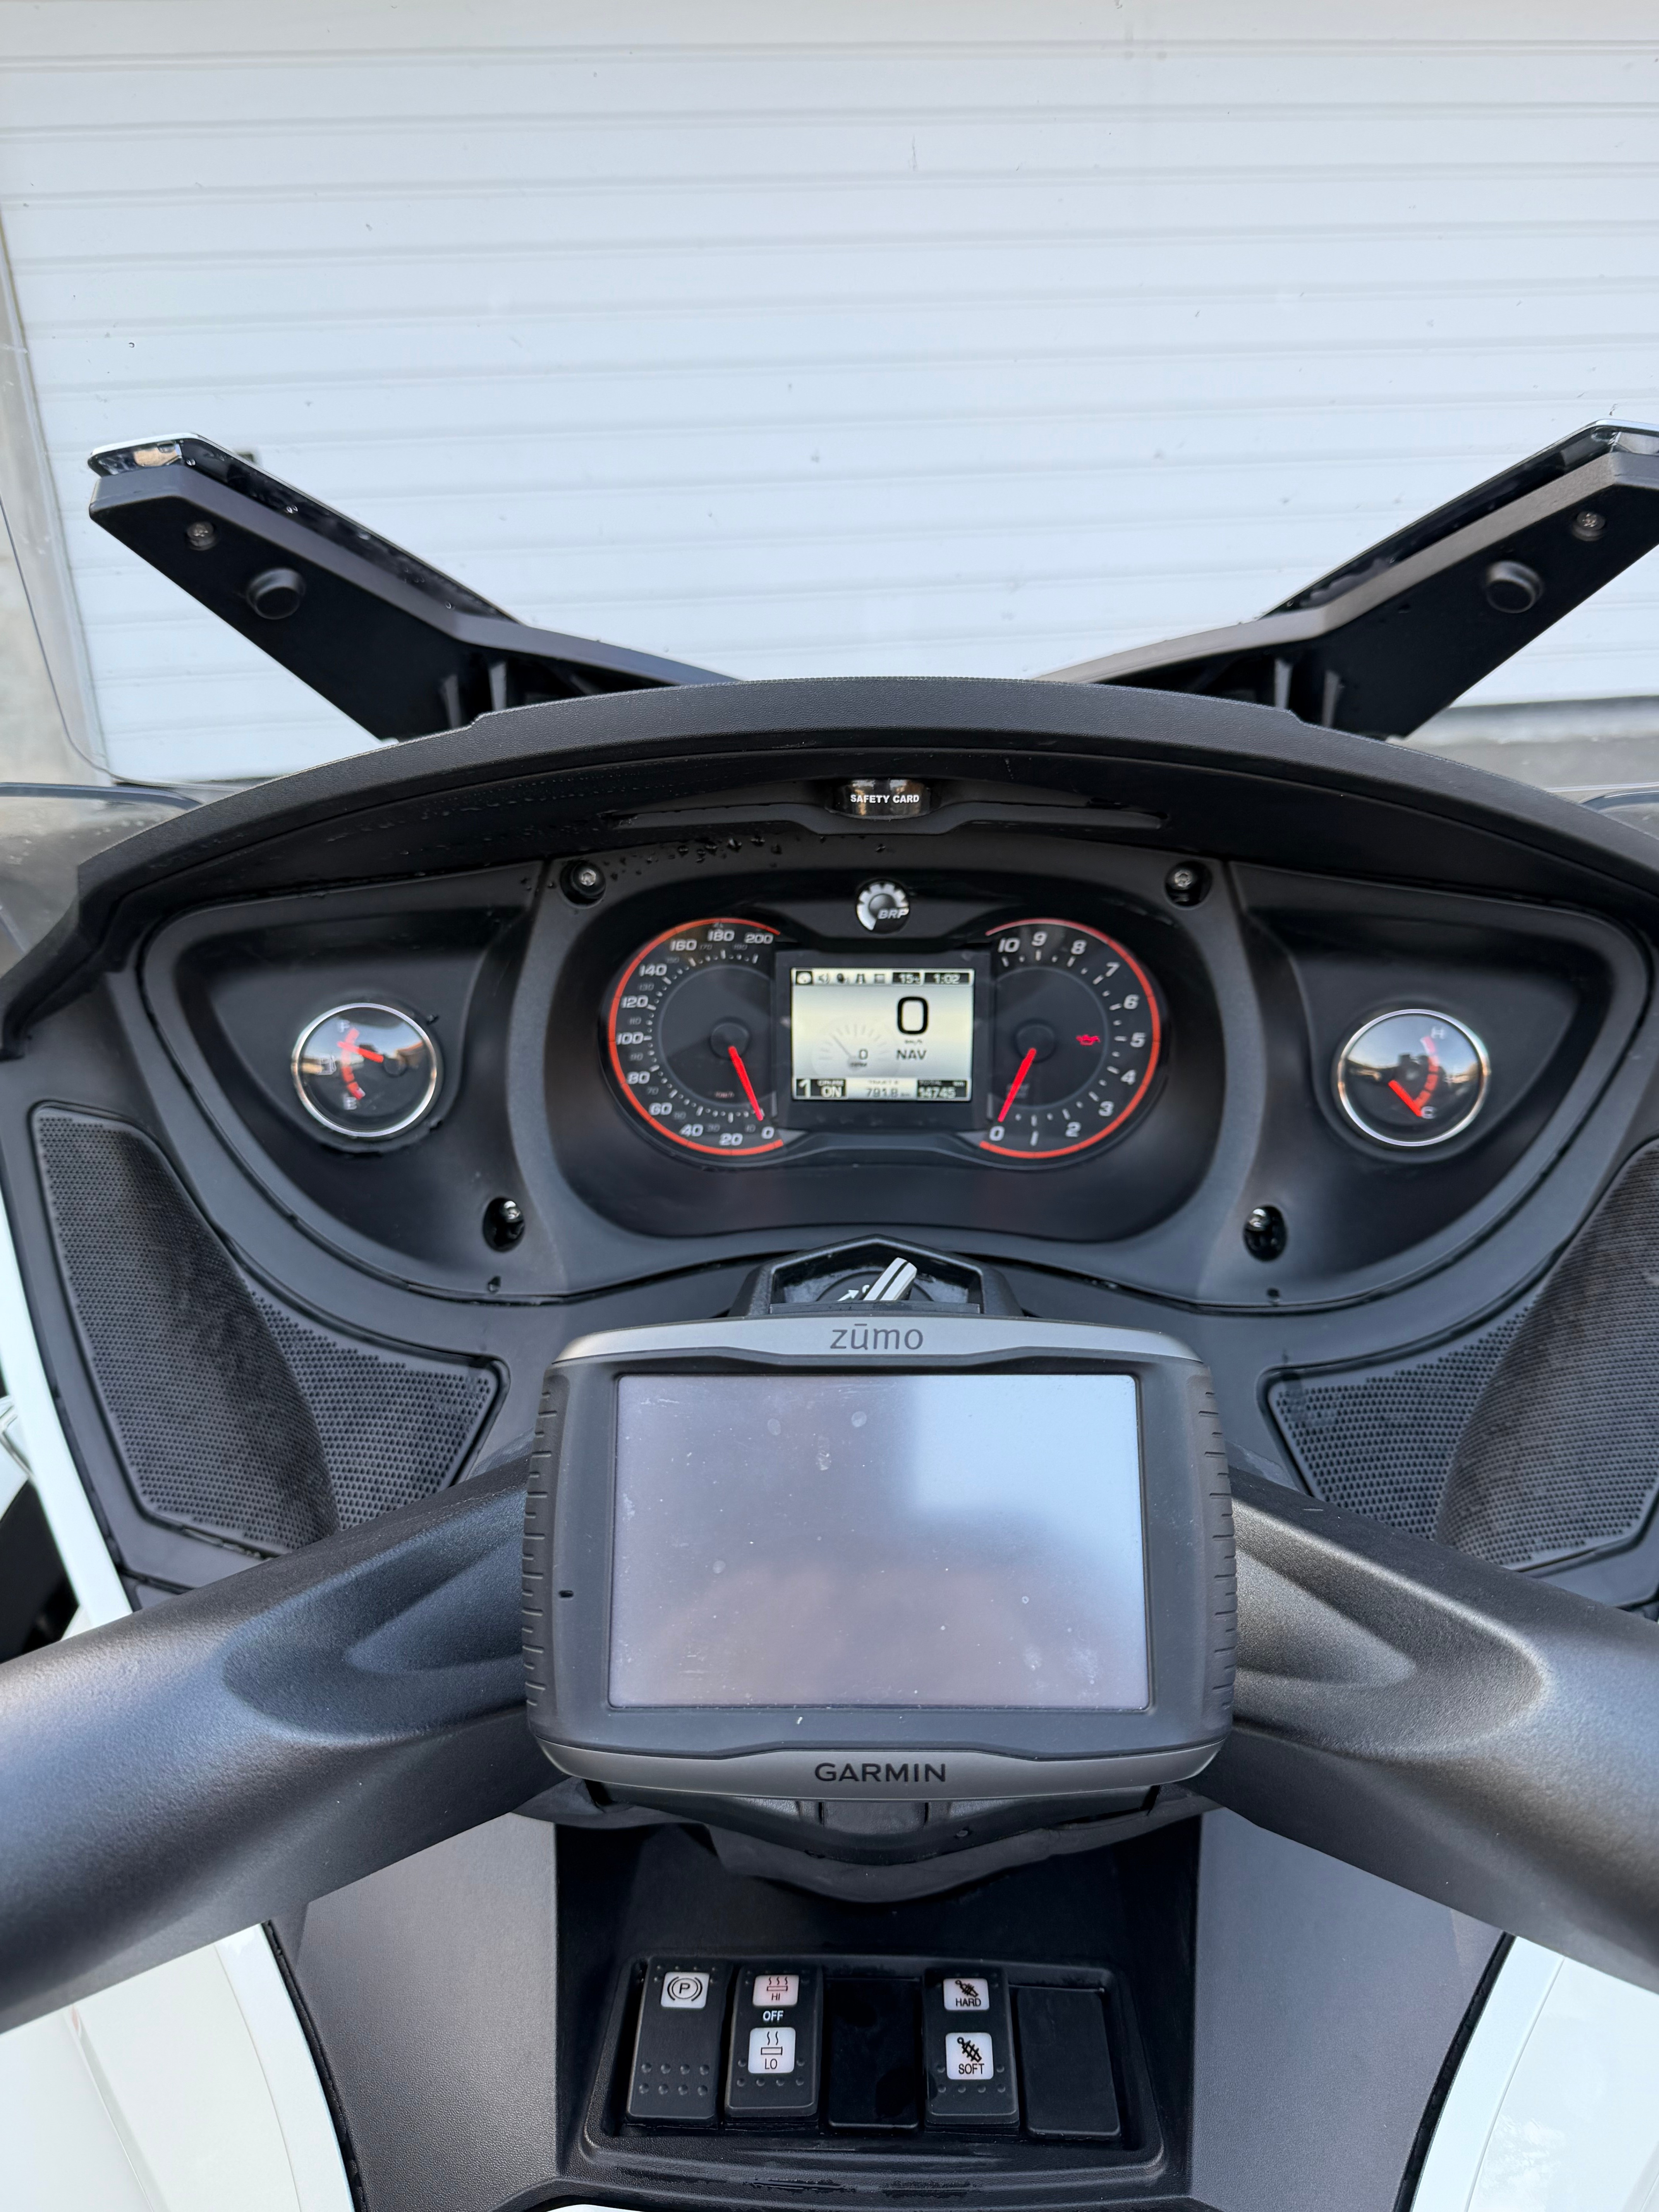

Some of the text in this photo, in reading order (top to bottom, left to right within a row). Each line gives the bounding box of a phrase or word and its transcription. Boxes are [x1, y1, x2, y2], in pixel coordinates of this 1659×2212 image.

[850, 795, 919, 803] SAFETY CARD
[877, 907, 909, 919] BRP
[708, 930, 735, 942] 180
[745, 933, 773, 944] 200
[1032, 931, 1047, 946] 9
[670, 939, 697, 951] 160
[998, 938, 1020, 952] 10
[1071, 940, 1087, 954] 8
[639, 963, 667, 976] 140
[1106, 962, 1120, 977] 7
[622, 995, 649, 1008] 120
[1123, 994, 1140, 1009] 6
[897, 996, 929, 1035] 0
[617, 1032, 644, 1044] 100
[1130, 1032, 1146, 1047] 5
[1432, 1028, 1445, 1039] H
[859, 1049, 868, 1060] 0
[896, 1049, 927, 1061] NAV
[627, 1072, 650, 1084] 80
[1121, 1070, 1136, 1084] 4
[821, 1086, 842, 1098] ON
[649, 1103, 672, 1115] 60
[1098, 1101, 1114, 1116] 3
[1421, 1106, 1435, 1119] C
[680, 1124, 703, 1137] 40
[761, 1127, 774, 1139] 0
[989, 1126, 1005, 1141] 0
[1065, 1122, 1081, 1137] 2
[719, 1133, 743, 1146] 20
[1030, 1131, 1038, 1146] 1
[830, 1324, 923, 1350] zūmo
[815, 1762, 946, 1782] GARMIN
[679, 1983, 690, 1994] P
[956, 1998, 981, 2007] HARD
[763, 2011, 784, 2023] OFF
[764, 2059, 778, 2069] LO
[958, 2064, 985, 2075] SOFT
